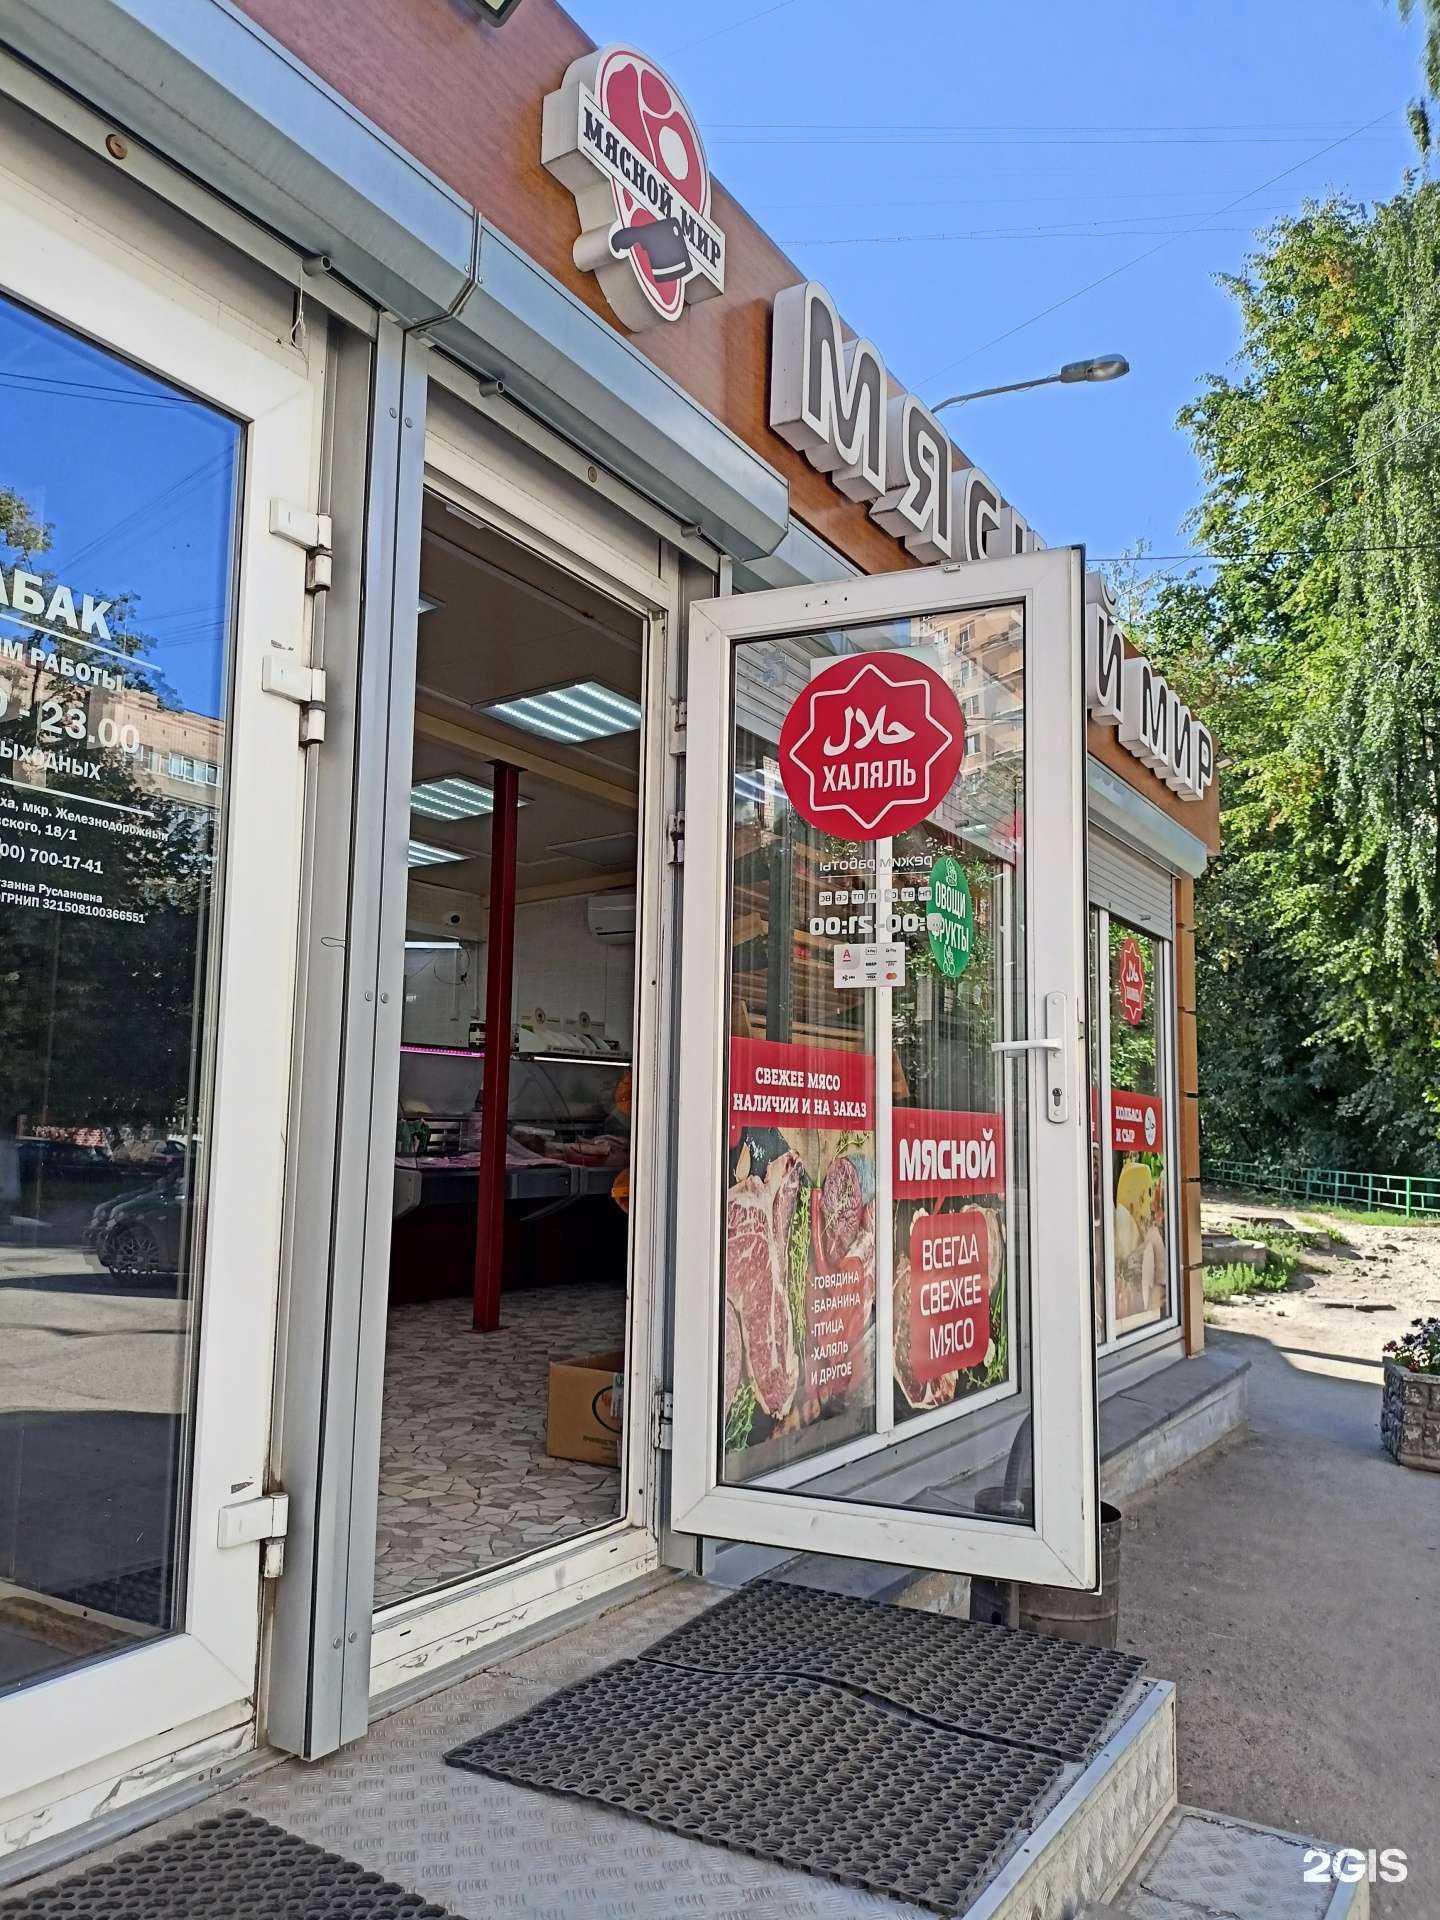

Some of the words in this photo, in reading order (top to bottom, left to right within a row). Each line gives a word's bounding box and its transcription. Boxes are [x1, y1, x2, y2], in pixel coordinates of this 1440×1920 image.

[583, 107, 673, 219] МЯСНОЙ
[680, 205, 721, 268] МИР
[0, 568, 112, 641] БАК
[30, 647, 123, 692] РАБОТЫ
[41, 701, 140, 754] 23.00
[823, 705, 916, 757] حلال
[1139, 663, 1214, 800] МИР
[822, 758, 917, 792] ХАЛЯЛЬ
[22, 802, 52, 817] мкр.
[0, 816, 42, 835] ского,
[45, 824, 78, 841] 18/1
[0, 842, 25, 862] 00)
[29, 848, 104, 875] 700-17-41
[0, 878, 35, 893] занна
[39, 883, 103, 903] Руслановна
[0, 892, 39, 908] ГРНИП
[42, 898, 146, 924] 321508100366551
[935, 881, 966, 918] ОВОЩИ
[755, 1067, 804, 1088] СВЕЖЕЕ
[808, 1072, 841, 1091] МЯСО
[733, 1093, 799, 1114] НАЛИЧИИ
[802, 1098, 810, 1115] И
[814, 1099, 830, 1116] НА
[833, 1100, 867, 1118] ЗАКАЗ
[899, 1128, 996, 1182] МЯСНОЙ
[922, 1233, 980, 1271] ВСЕГДА
[920, 1274, 982, 1316] СВЕЖЕЕ
[929, 1317, 975, 1360] МЯСО
[811, 1371, 818, 1386] И
[819, 1361, 853, 1386] ДРУГОЕ
